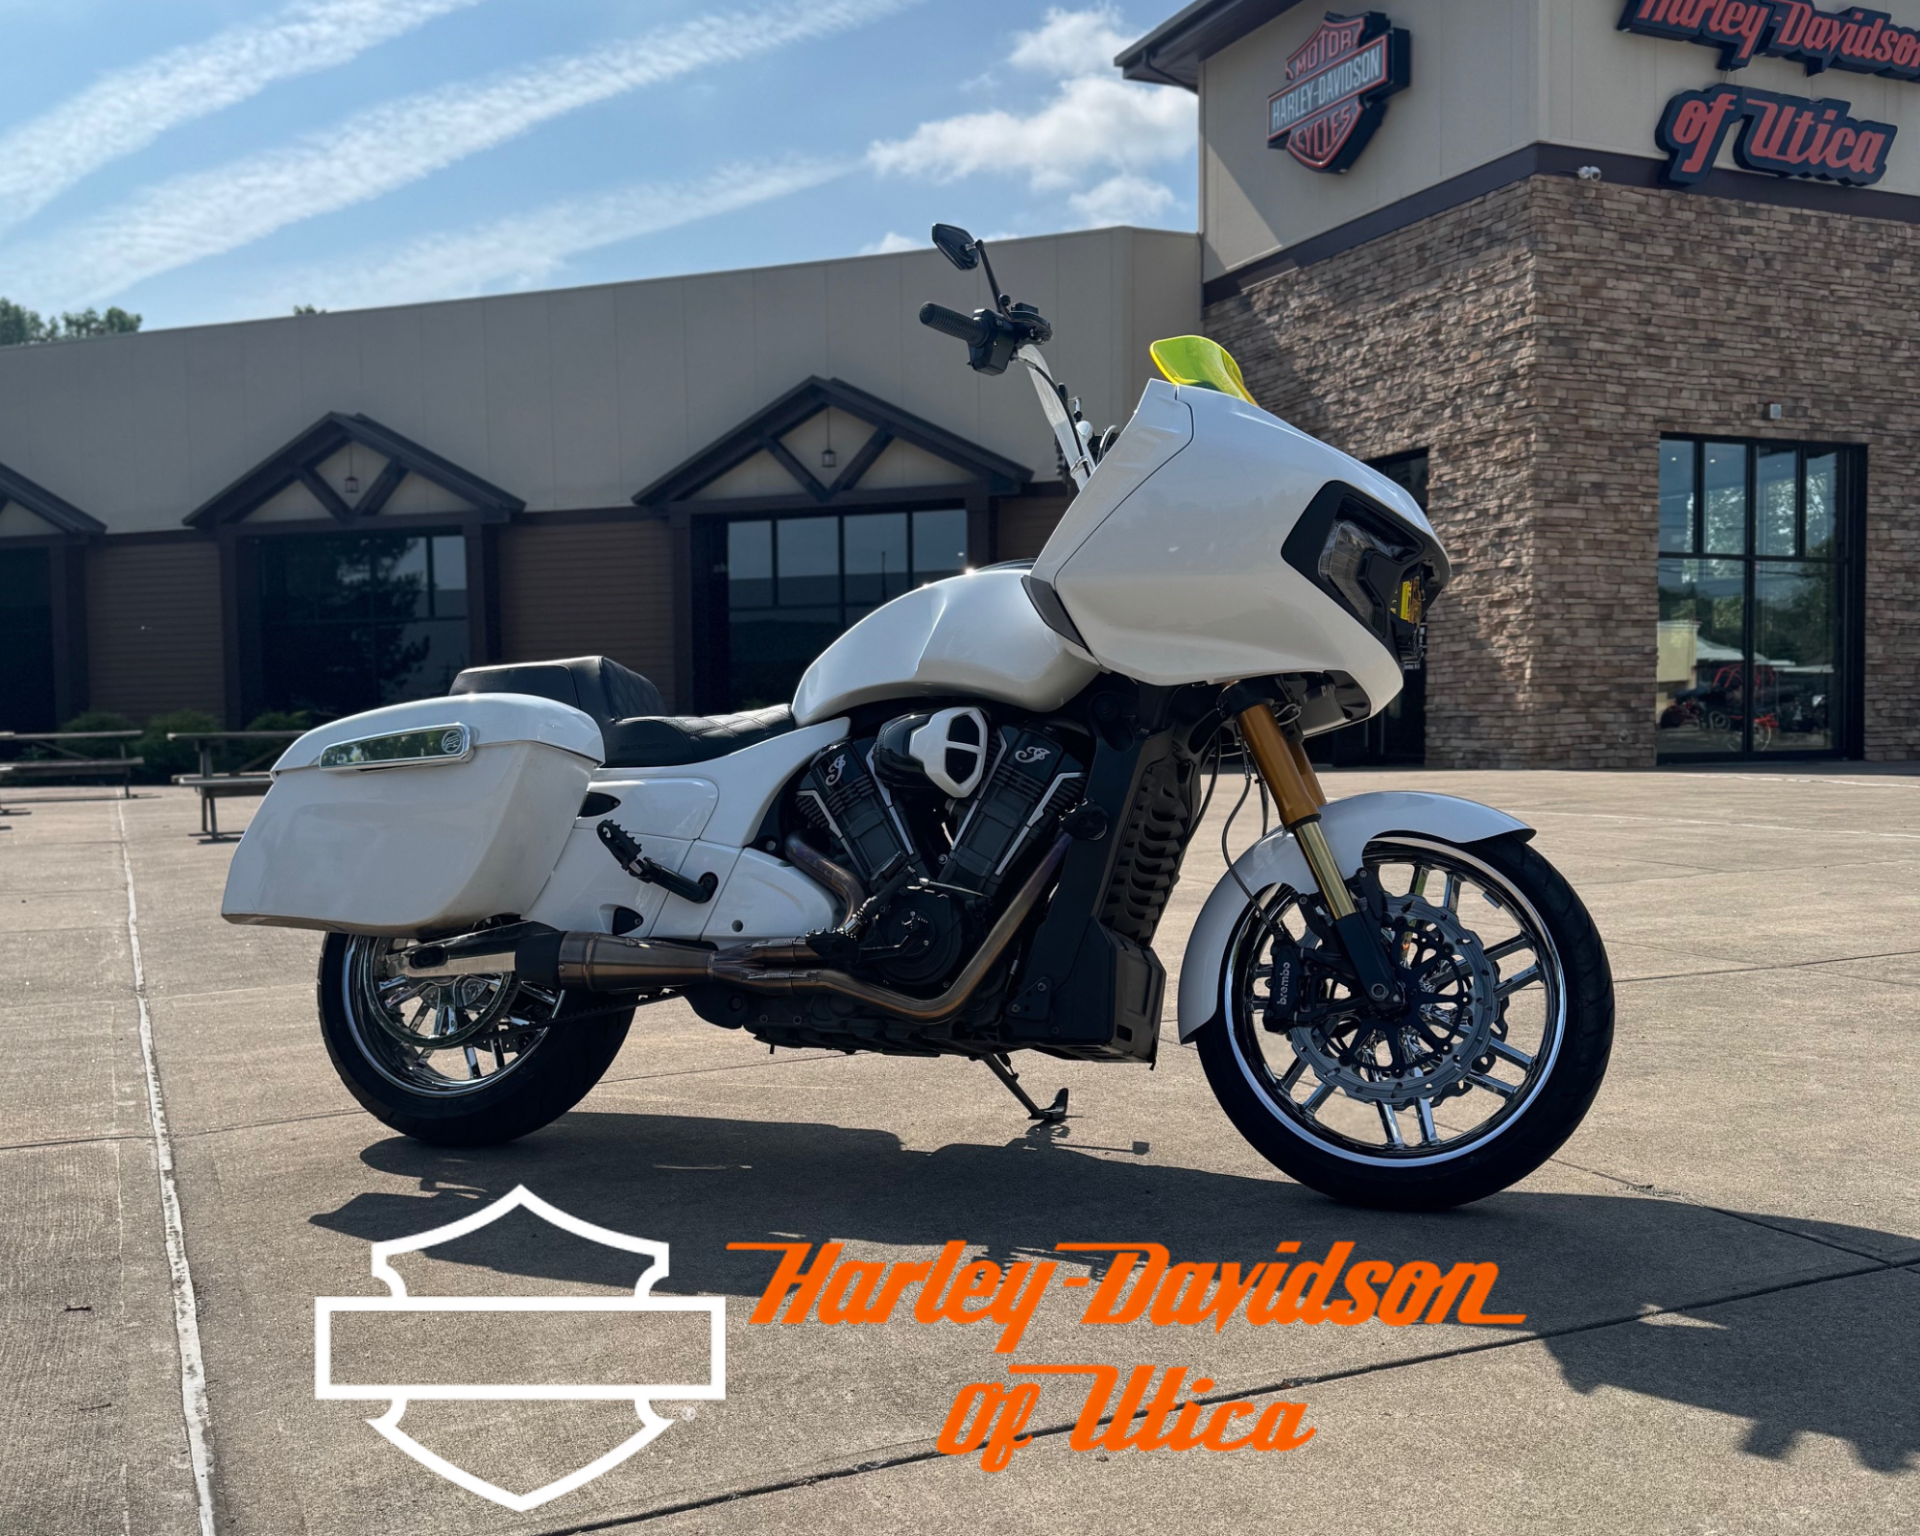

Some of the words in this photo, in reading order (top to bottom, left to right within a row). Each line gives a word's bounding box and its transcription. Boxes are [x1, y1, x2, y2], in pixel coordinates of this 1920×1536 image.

[1295, 30, 1353, 76] MOTOR
[1272, 46, 1381, 130] HARLEY-DAVIDSON
[1295, 105, 1352, 159] CYCLES
[1673, 93, 1737, 173] of
[1746, 98, 1886, 174] Utica
[1277, 961, 1291, 1005] brembo
